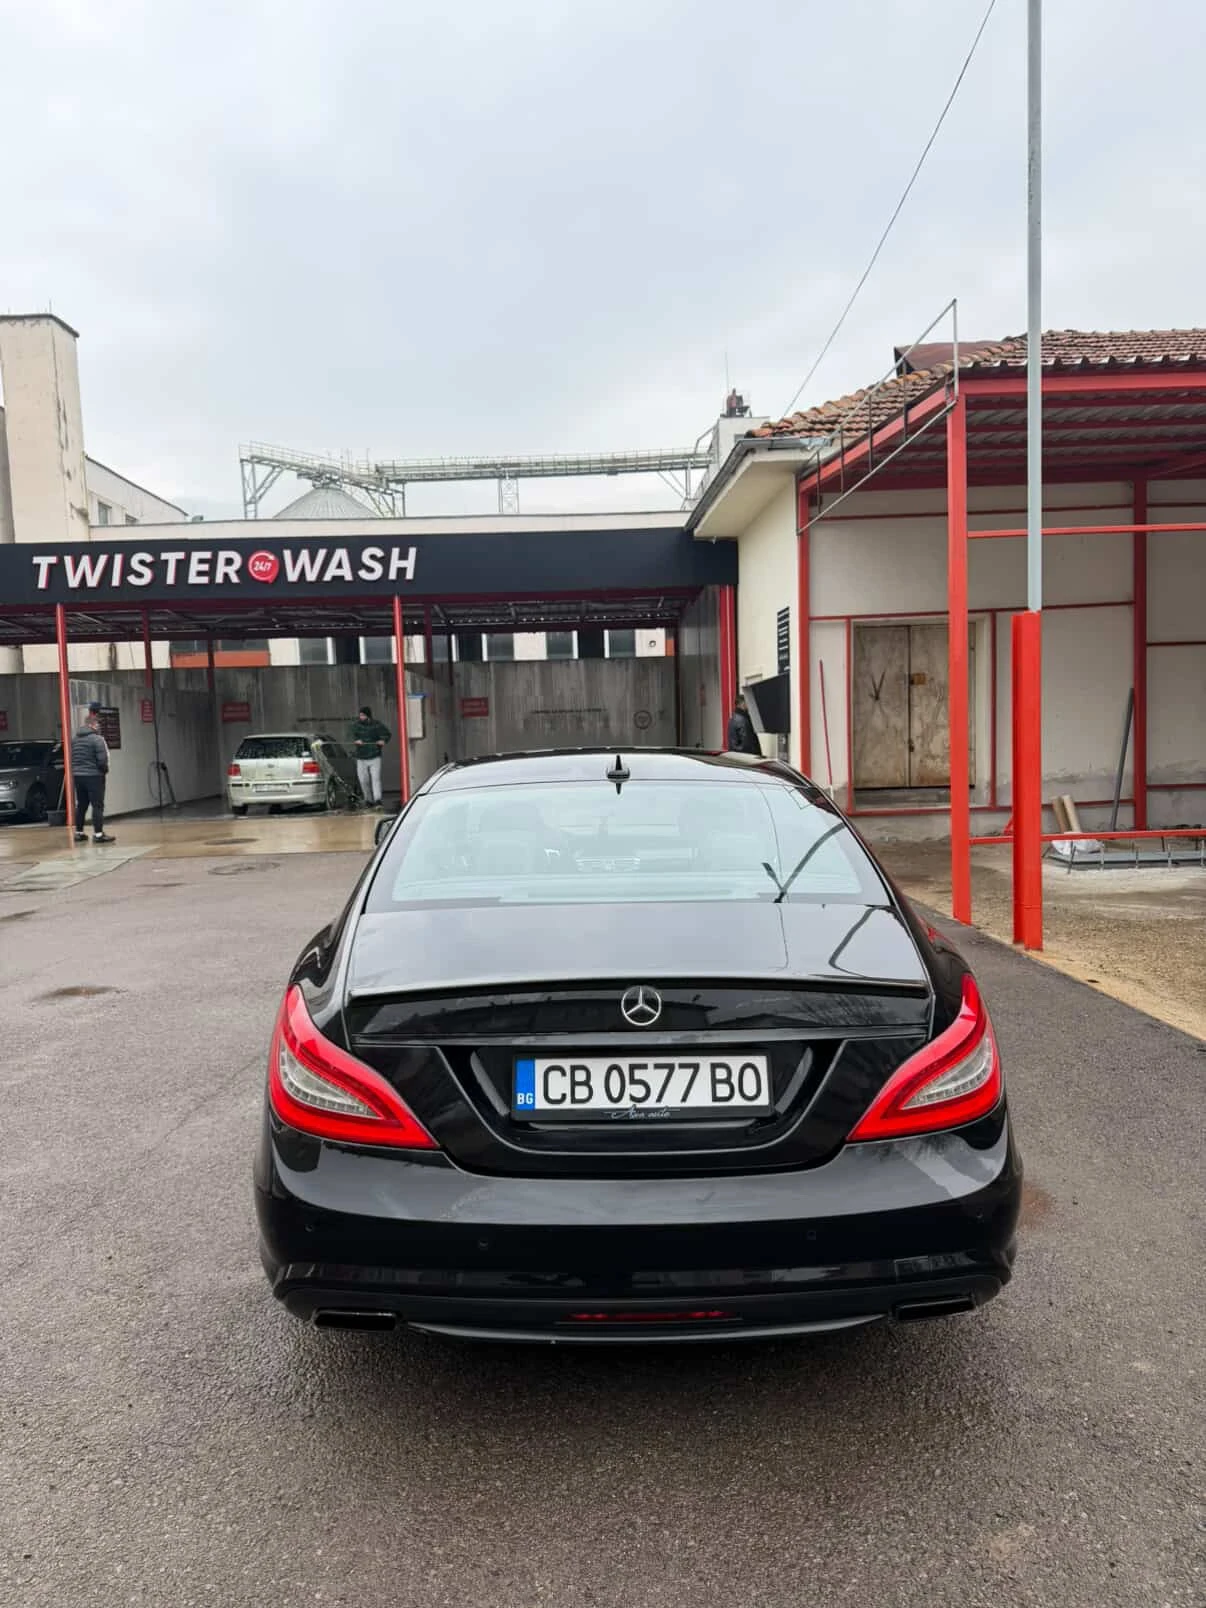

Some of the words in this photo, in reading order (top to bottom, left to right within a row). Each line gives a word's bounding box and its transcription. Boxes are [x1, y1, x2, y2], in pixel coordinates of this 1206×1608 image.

[32, 550, 240, 589] TWISTER
[283, 547, 417, 583] WASH
[517, 1093, 533, 1104] BG
[543, 1064, 594, 1105] CB
[604, 1063, 700, 1104] 0577
